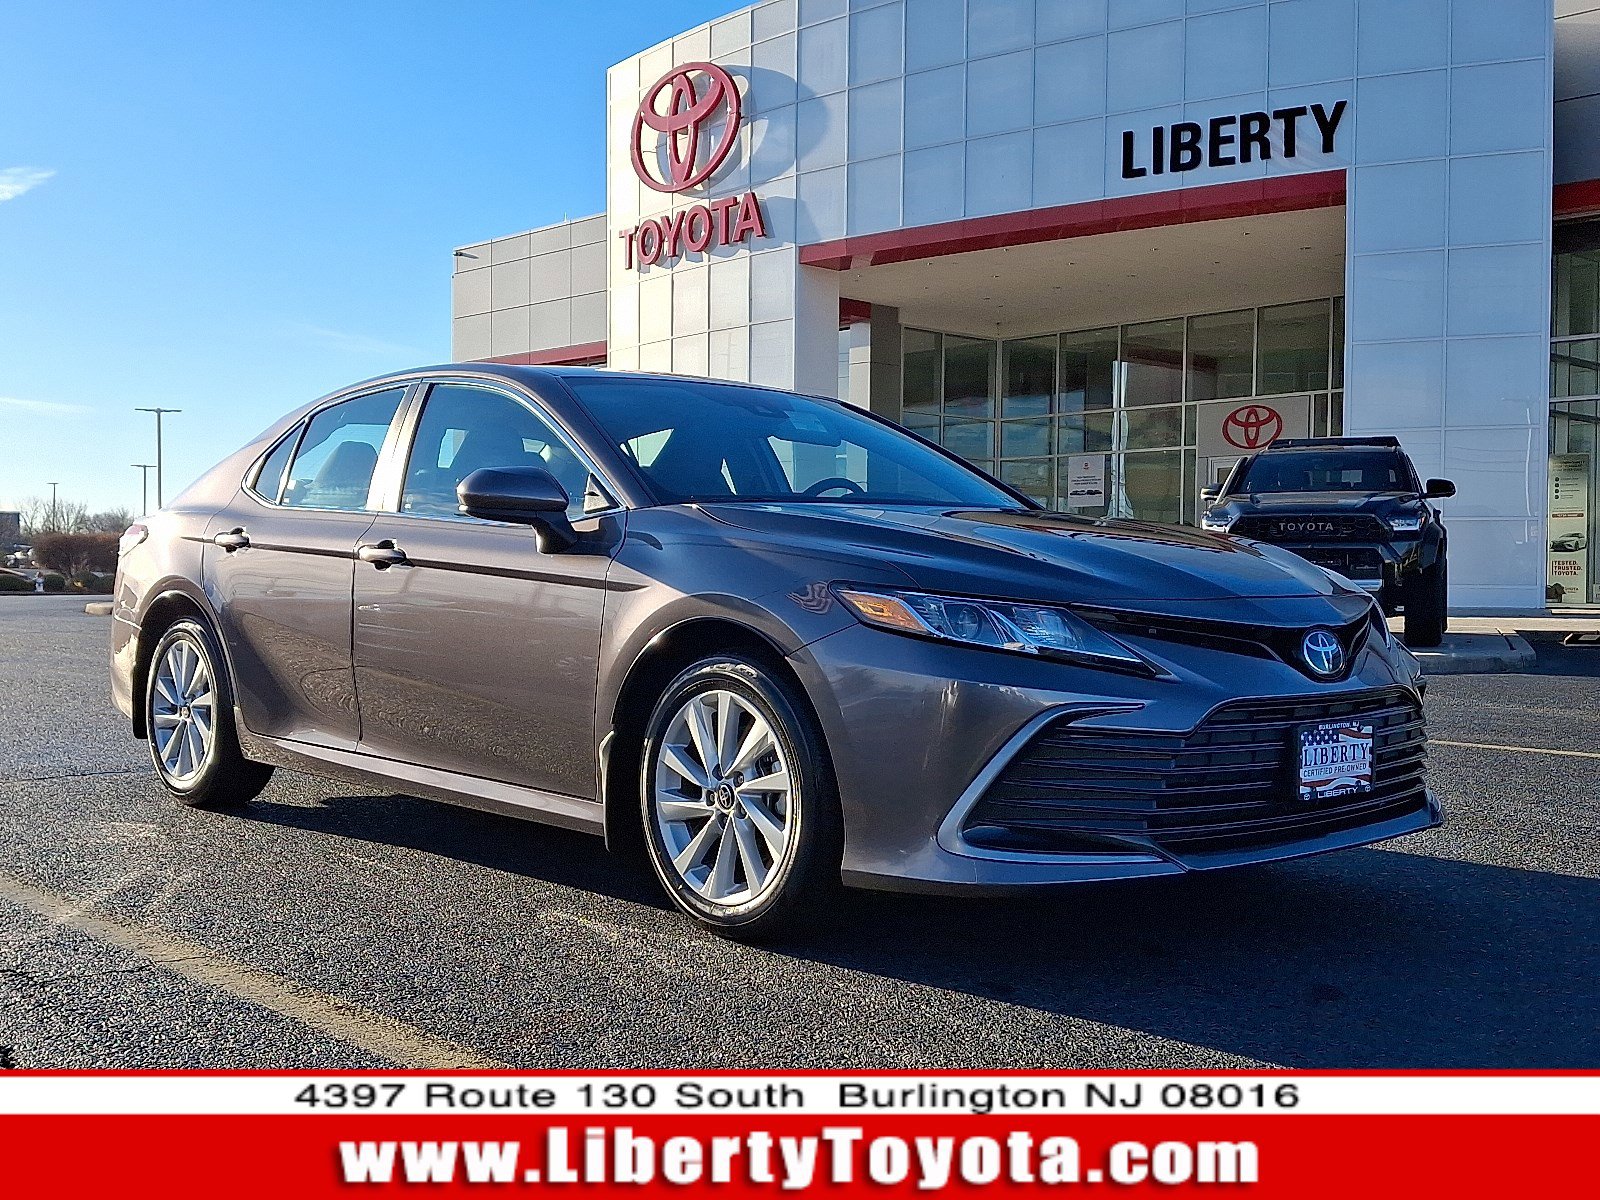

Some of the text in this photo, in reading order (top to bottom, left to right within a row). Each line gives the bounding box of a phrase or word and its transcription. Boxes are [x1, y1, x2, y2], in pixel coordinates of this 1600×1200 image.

[1121, 100, 1348, 179] LIBERTY
[618, 191, 767, 270] TOYOTA
[1279, 522, 1334, 531] TOYOTA
[1303, 743, 1369, 766] LIBERTY
[1303, 763, 1367, 777] CERTIFIED PRE-OWNED
[1317, 787, 1358, 798] LIBERTY
